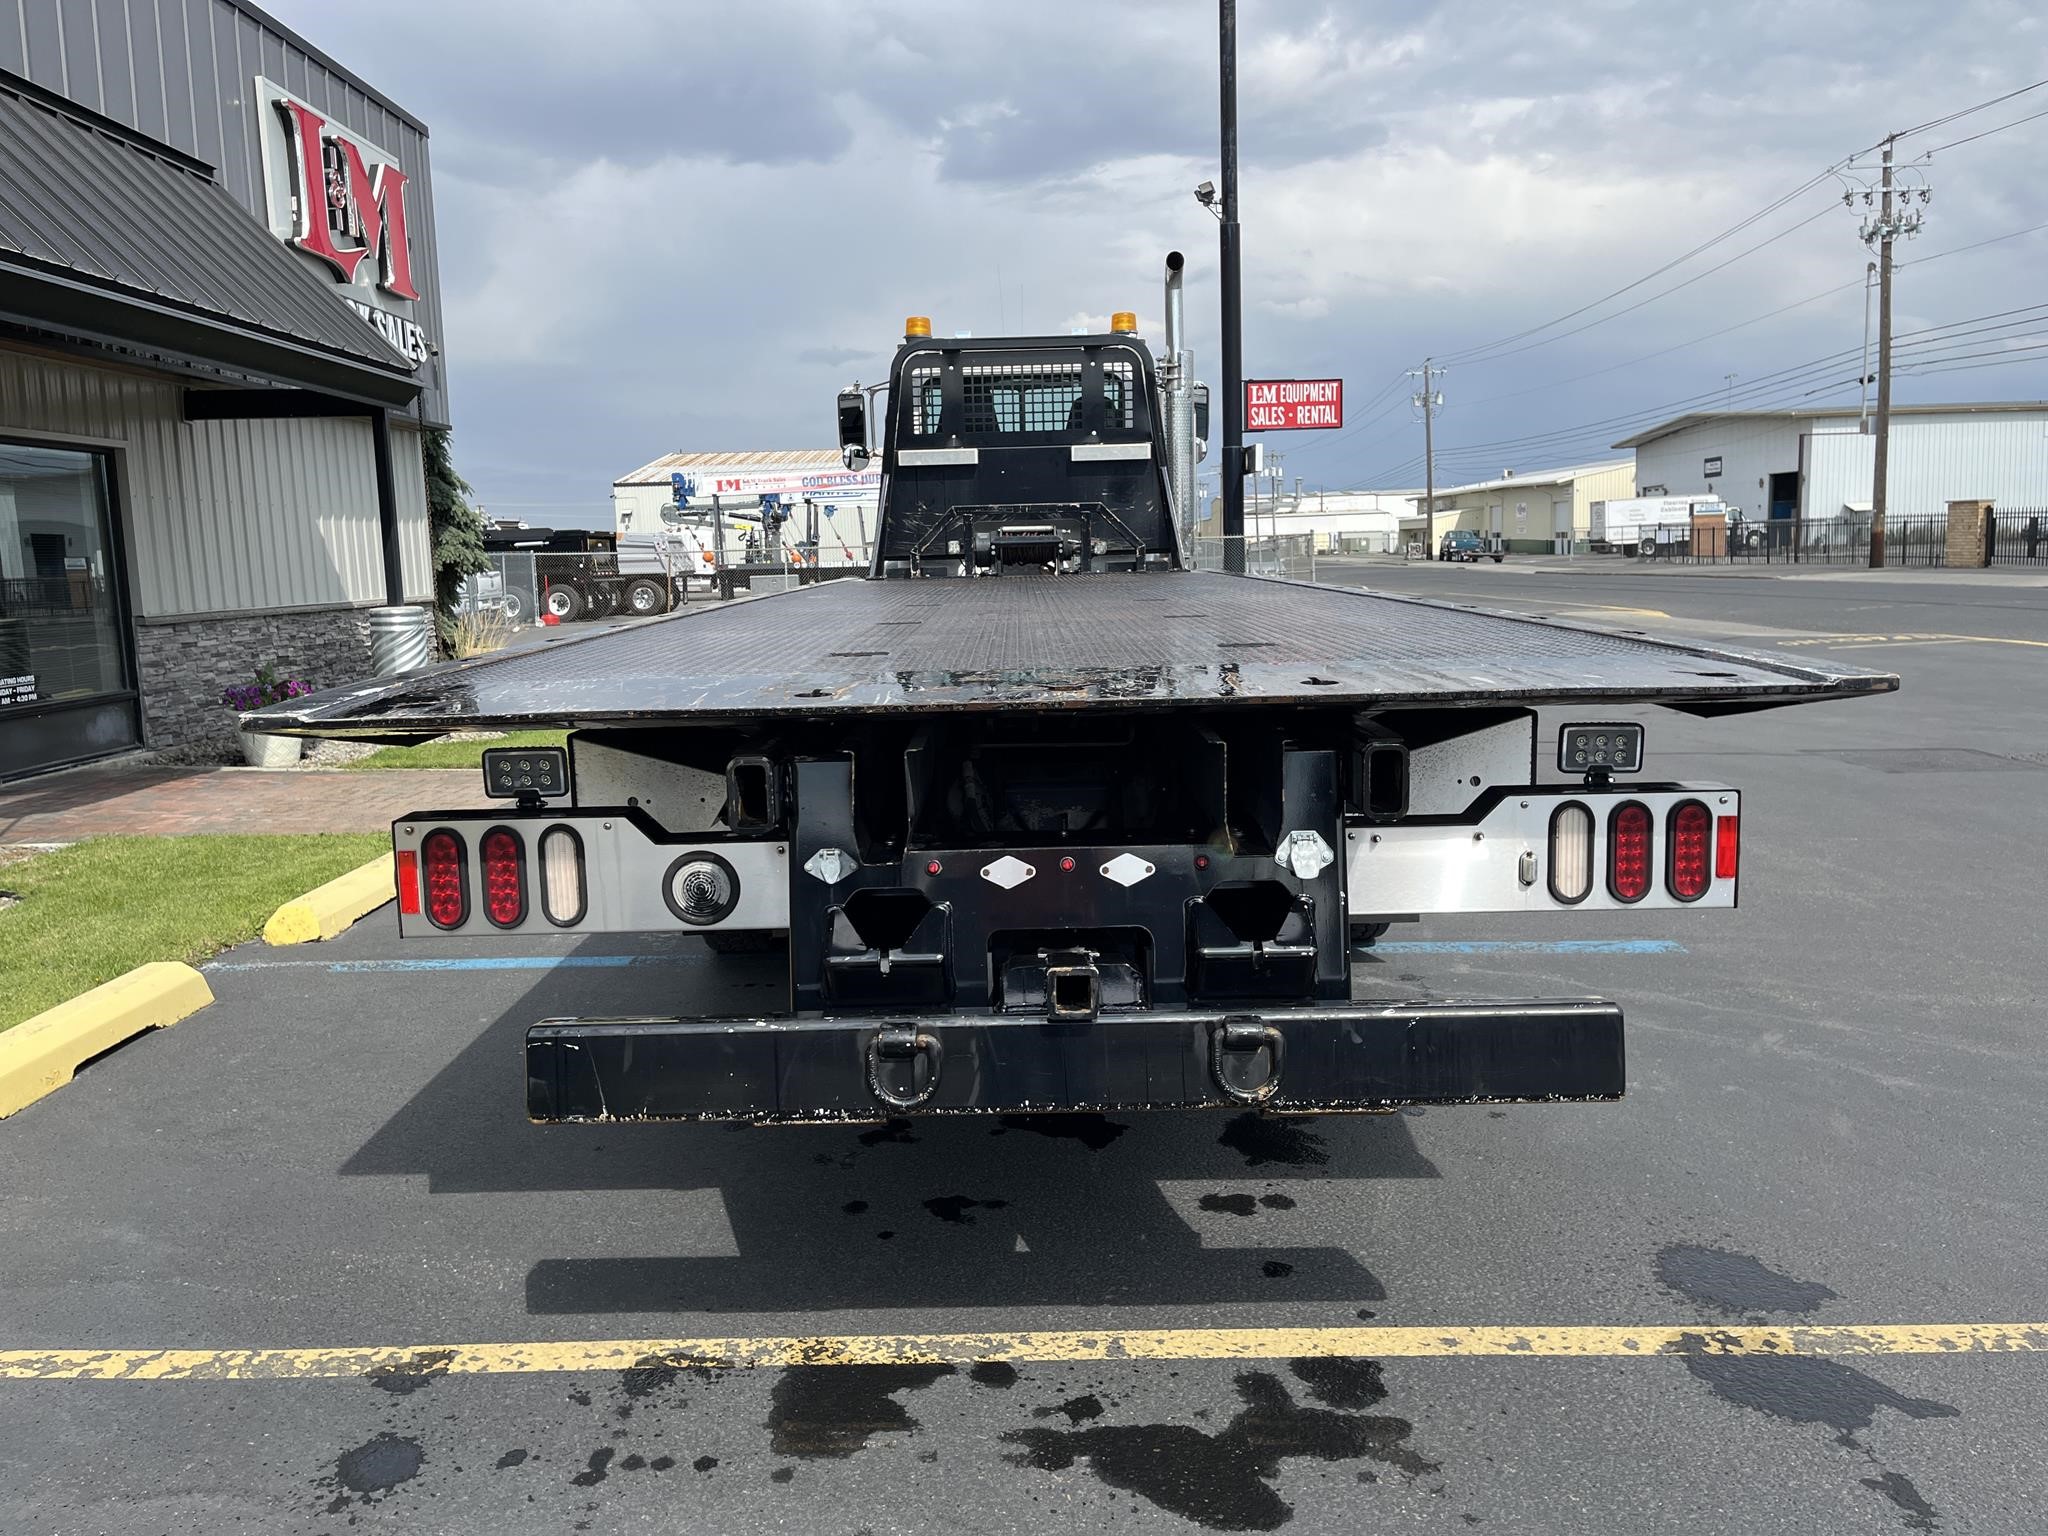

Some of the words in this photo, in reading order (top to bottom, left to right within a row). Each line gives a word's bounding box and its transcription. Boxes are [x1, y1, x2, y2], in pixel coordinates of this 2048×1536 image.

[373, 309, 428, 363] SALES
[1250, 384, 1278, 404] L&M
[1280, 382, 1338, 403] EQUIPMENT
[1251, 406, 1286, 426] SALES
[1297, 404, 1338, 425] RENTAL
[802, 476, 824, 487] GOD
[826, 474, 858, 486] BLESS
